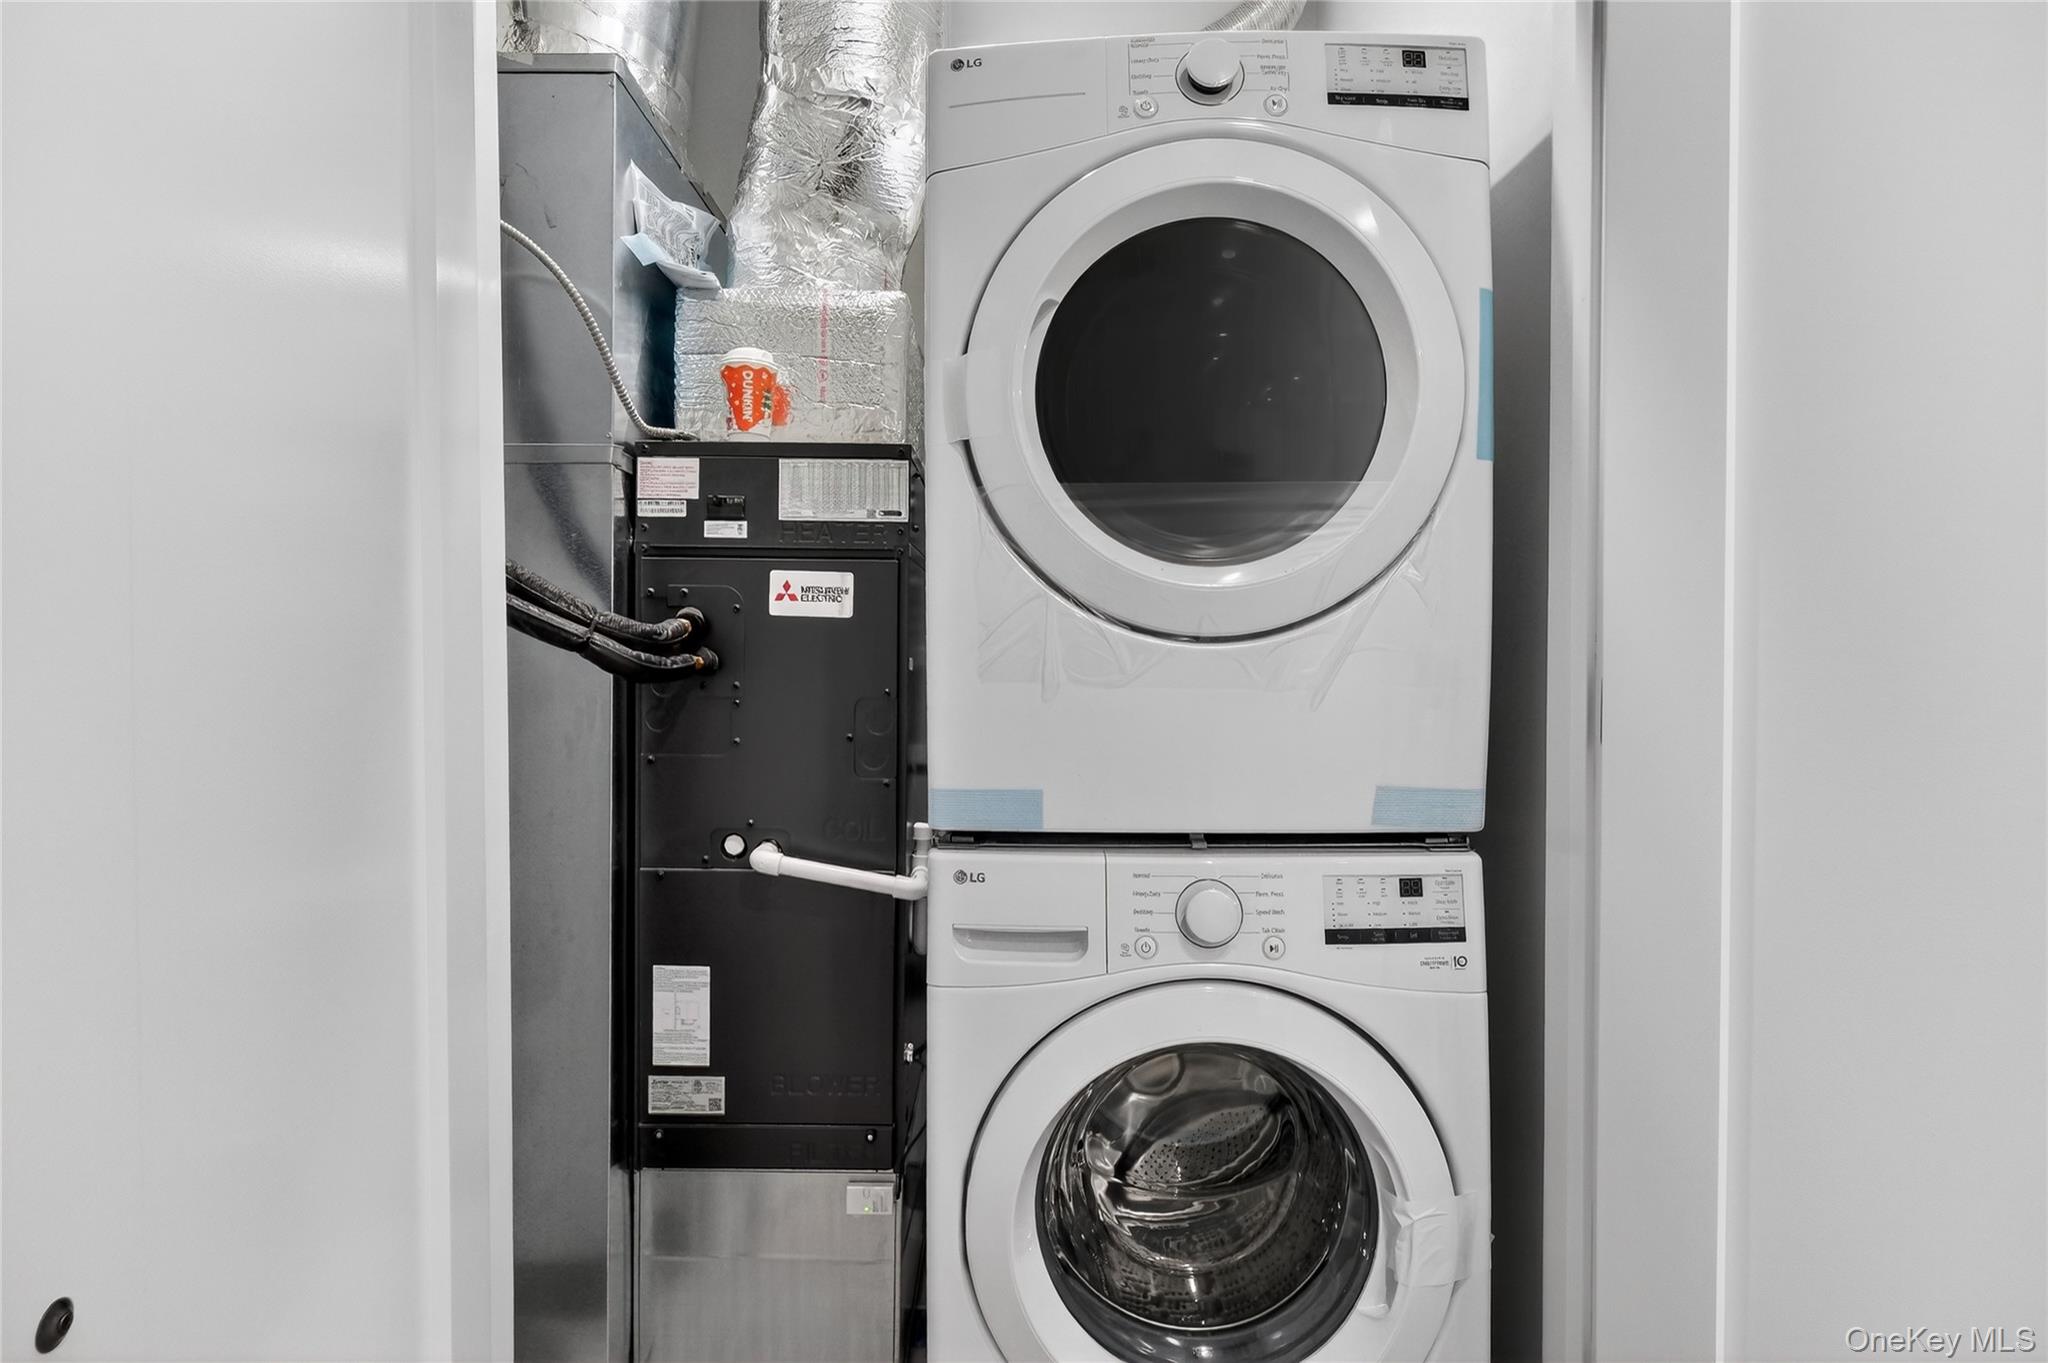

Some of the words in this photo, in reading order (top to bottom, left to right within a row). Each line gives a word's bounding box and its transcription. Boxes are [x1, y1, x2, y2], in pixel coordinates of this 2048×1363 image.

[967, 58, 982, 68] LG
[777, 521, 889, 544] HEATER
[801, 594, 842, 603] ELECTRIC
[969, 872, 985, 883] LG
